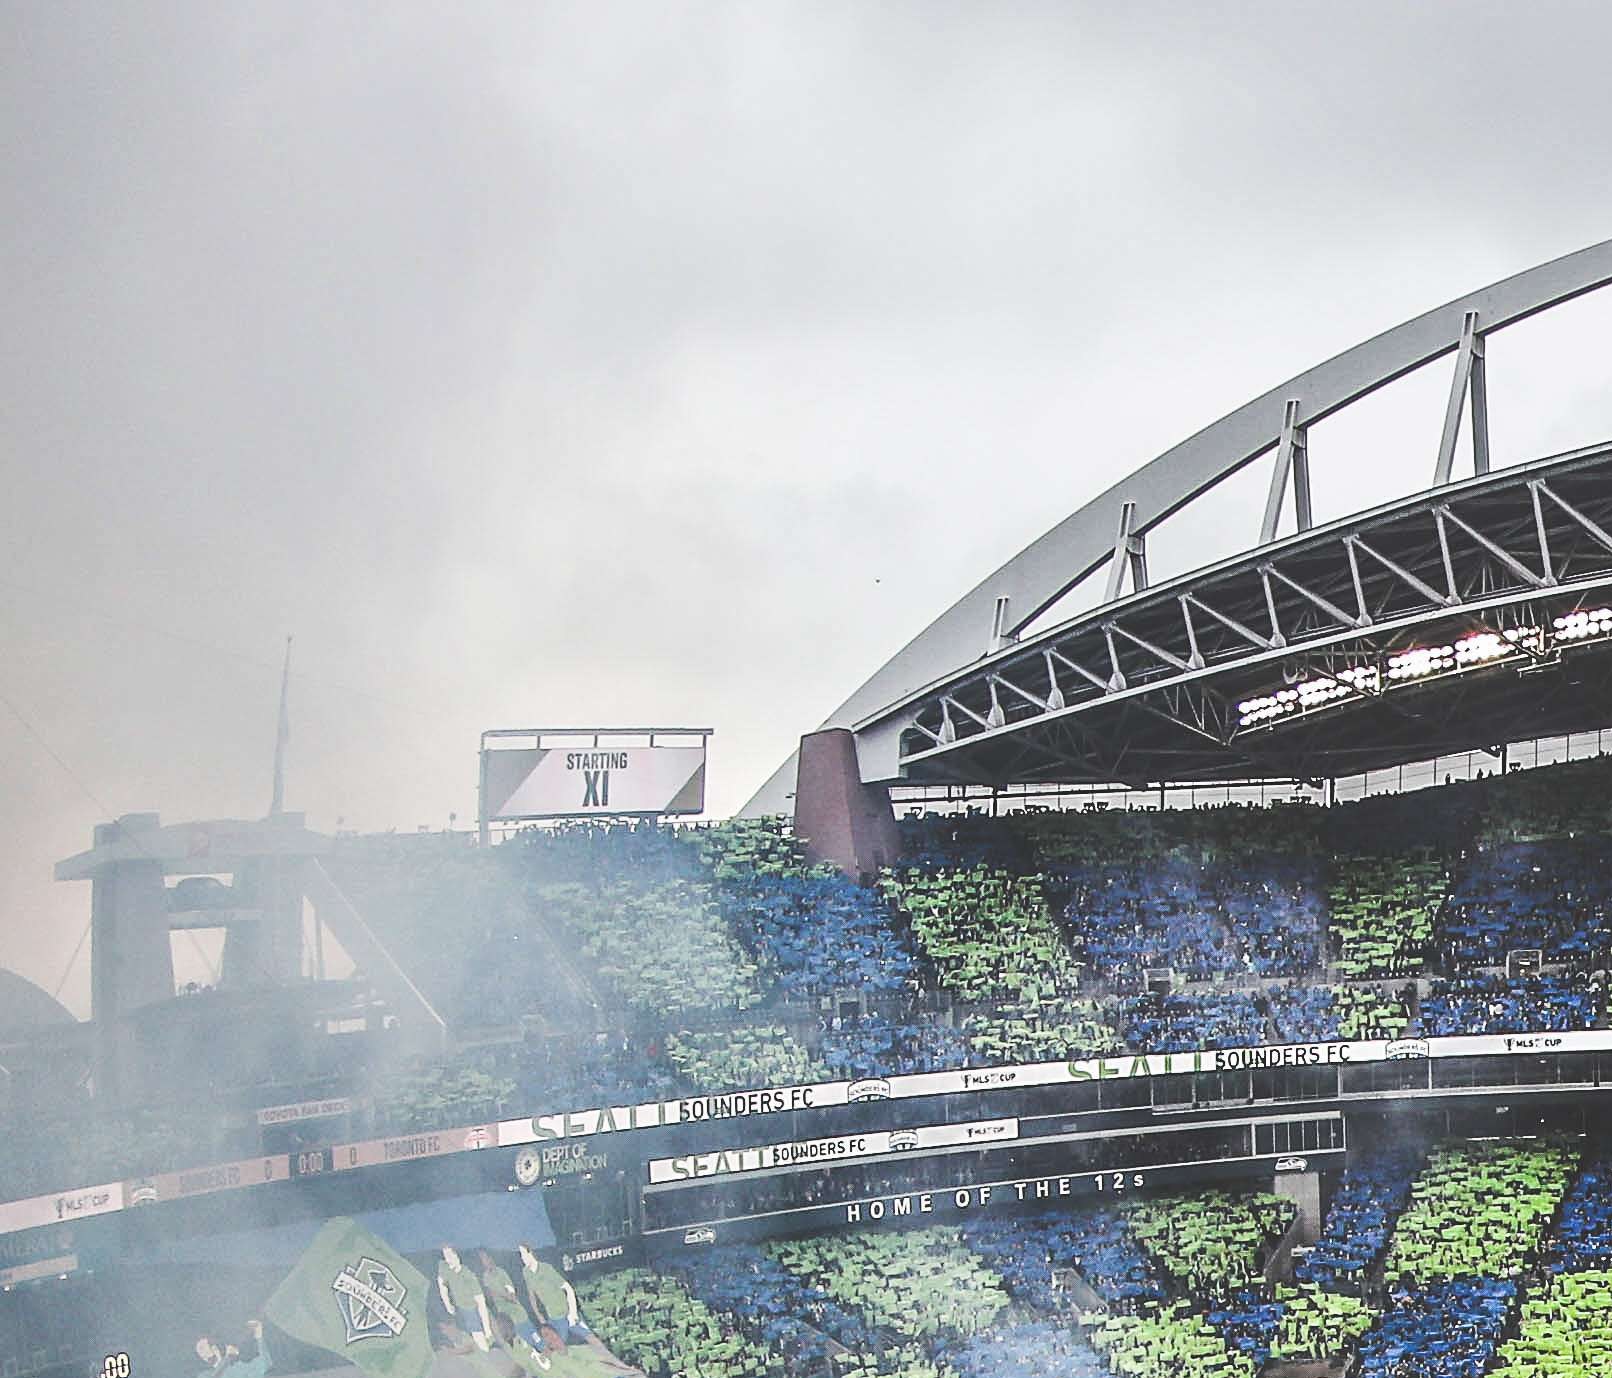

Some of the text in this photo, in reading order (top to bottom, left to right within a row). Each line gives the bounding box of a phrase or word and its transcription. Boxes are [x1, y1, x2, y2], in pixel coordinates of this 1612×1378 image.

[567, 752, 628, 770] STARTING
[583, 771, 608, 807] XI
[1544, 1038, 1562, 1047] CUP
[1216, 1045, 1350, 1071] SOUNDERS FC
[1000, 1073, 1016, 1082] CUP
[680, 1088, 814, 1122] SOUNDERS FC
[542, 1143, 588, 1163] DEPT OF
[773, 1140, 846, 1166] SOUNDERS
[849, 1138, 866, 1153] FC
[847, 1173, 1144, 1222] HOME OF THE 12s
[575, 1246, 624, 1265] STARBUCKS
